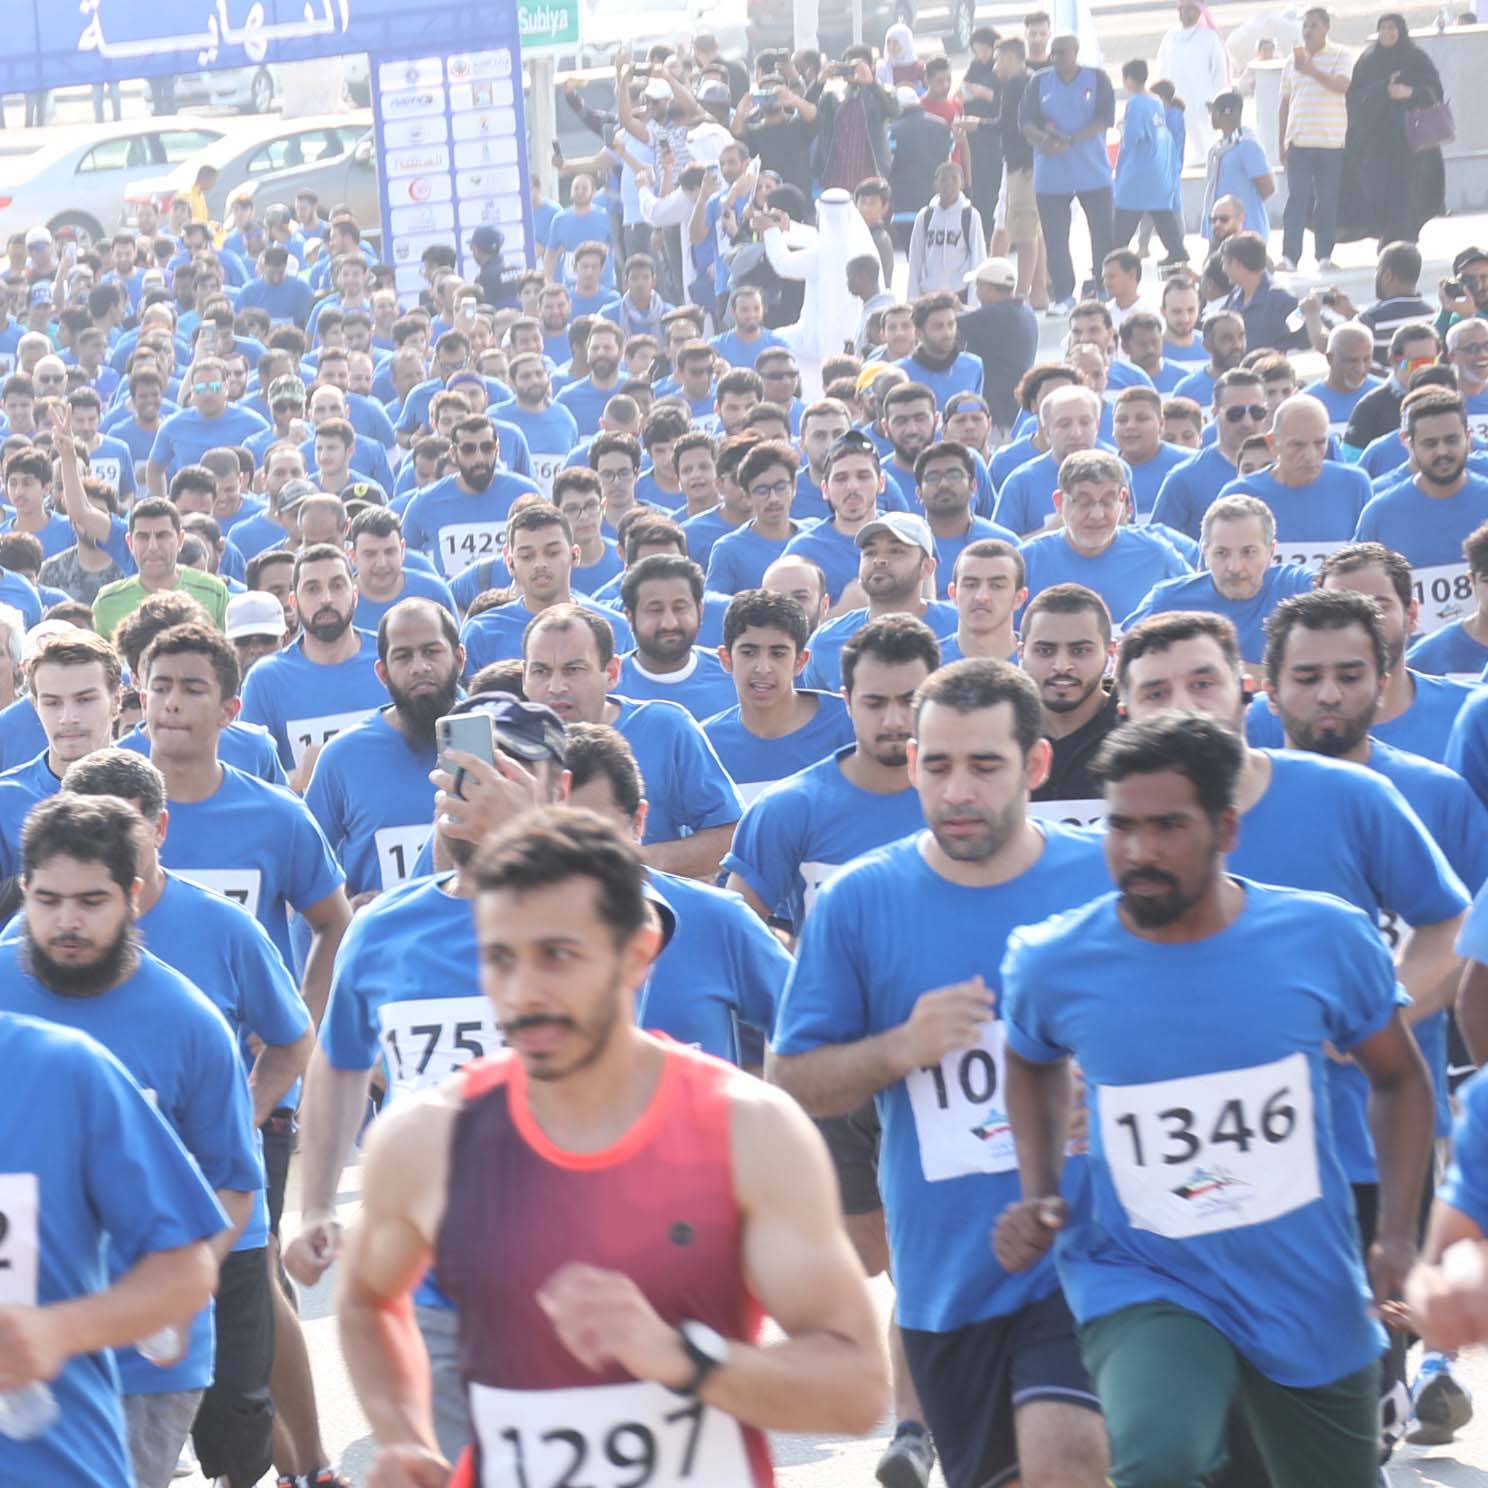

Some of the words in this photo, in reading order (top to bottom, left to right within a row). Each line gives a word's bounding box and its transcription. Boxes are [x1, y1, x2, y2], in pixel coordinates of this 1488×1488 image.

[518, 4, 569, 38] Subiya
[1414, 573, 1473, 605] 108
[387, 1020, 488, 1081] 175
[1117, 1087, 1295, 1167] 1346
